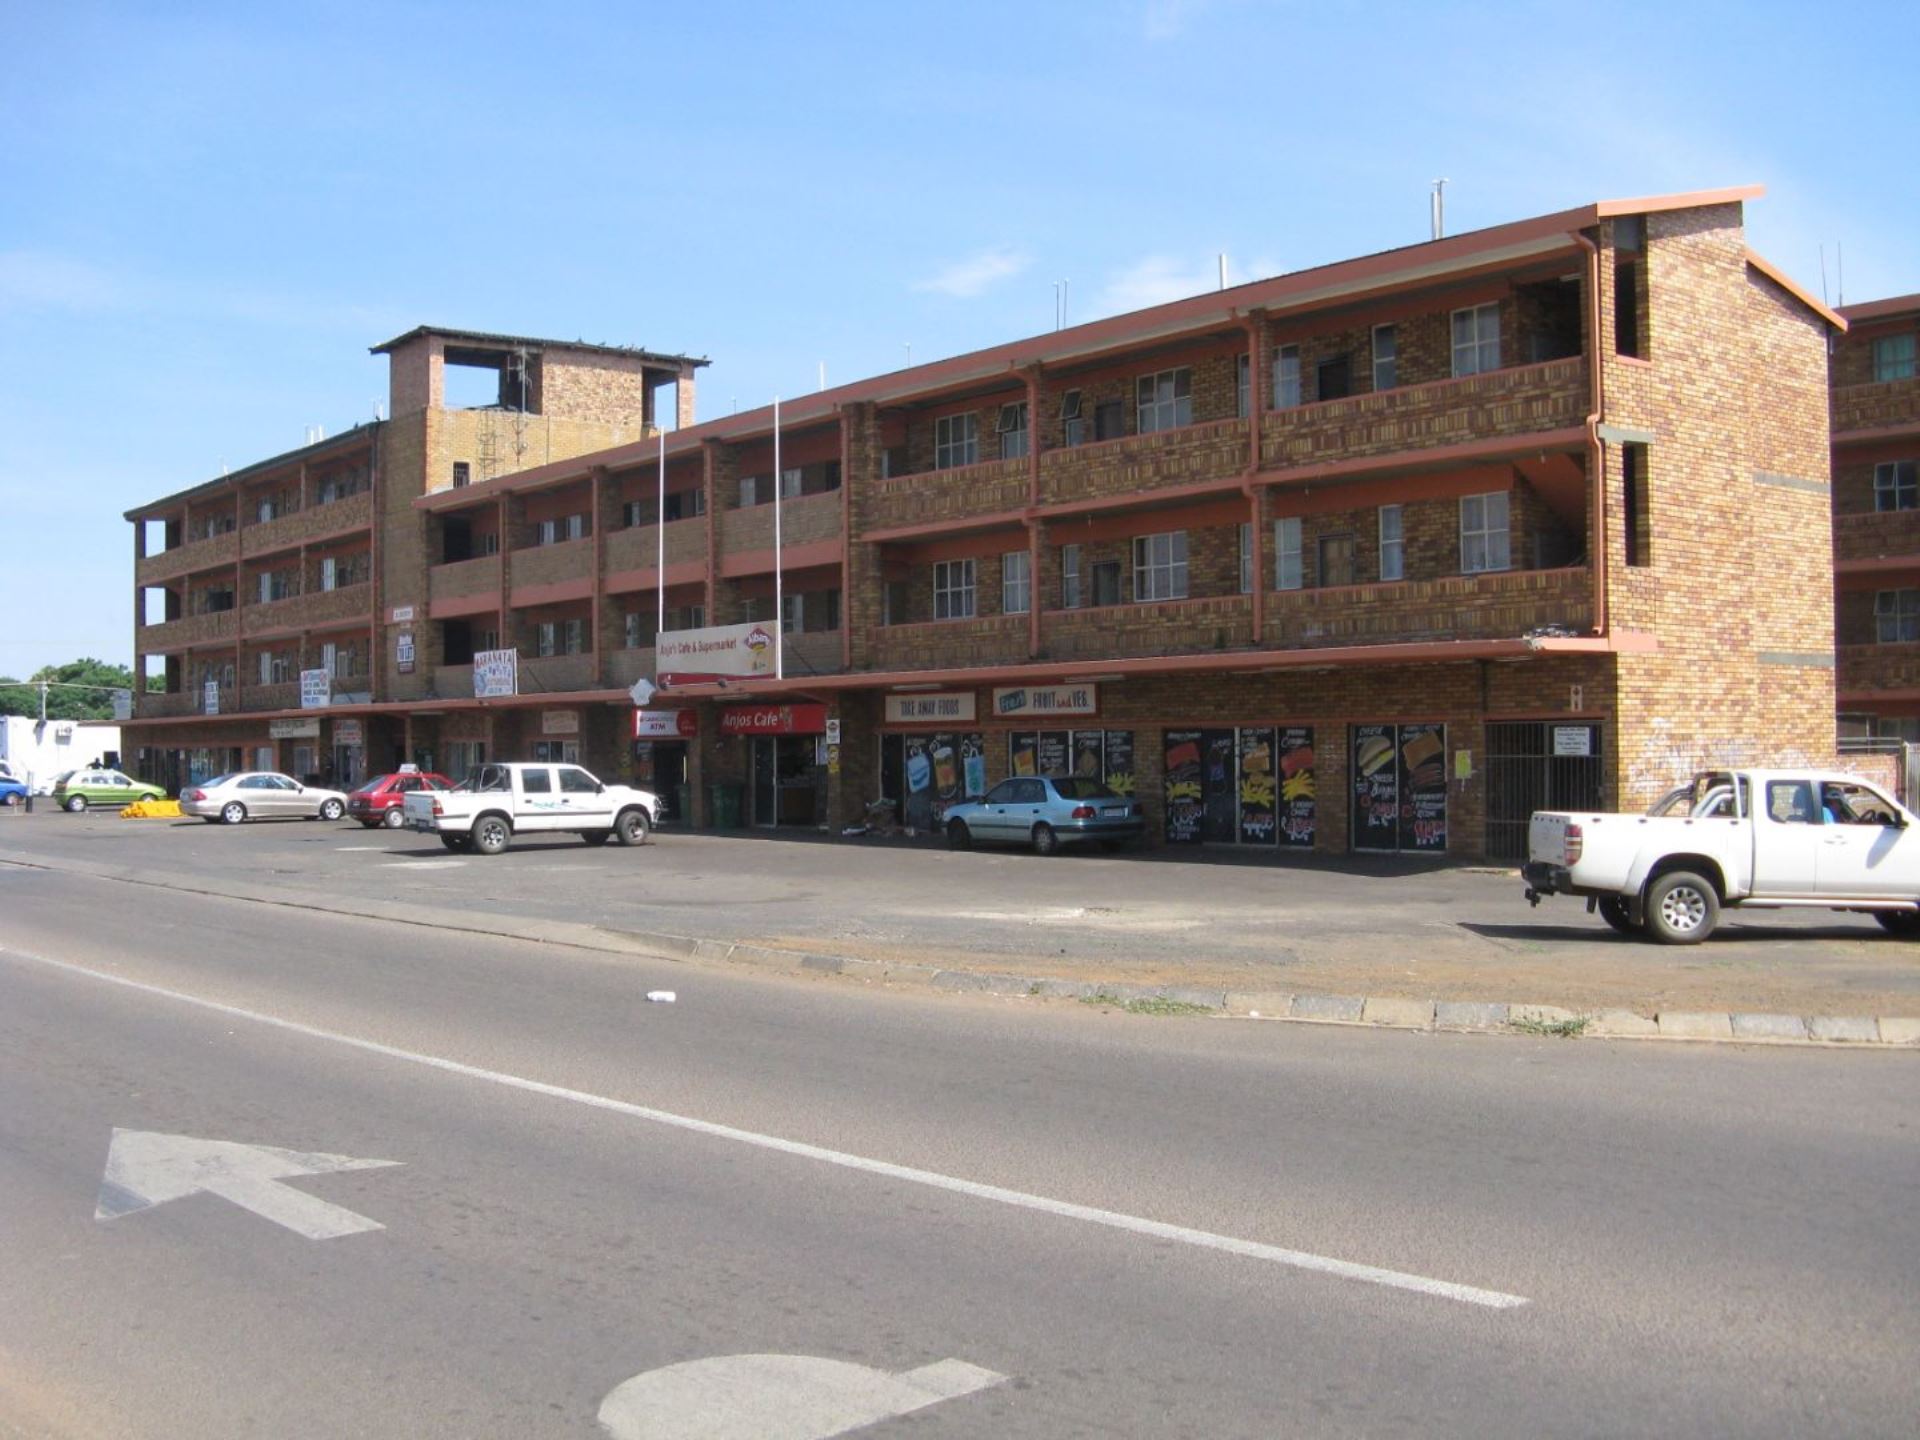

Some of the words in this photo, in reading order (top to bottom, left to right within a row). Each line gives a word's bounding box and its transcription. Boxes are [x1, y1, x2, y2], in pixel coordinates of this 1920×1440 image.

[678, 641, 691, 654] Cafe
[698, 637, 737, 655] Supermarket
[900, 700, 915, 717] TAKE
[918, 699, 935, 716] AWAY
[938, 698, 959, 715] FOODS
[1033, 691, 1056, 708] FRUIT
[722, 713, 751, 729] Anjos
[753, 712, 778, 727] Cafe
